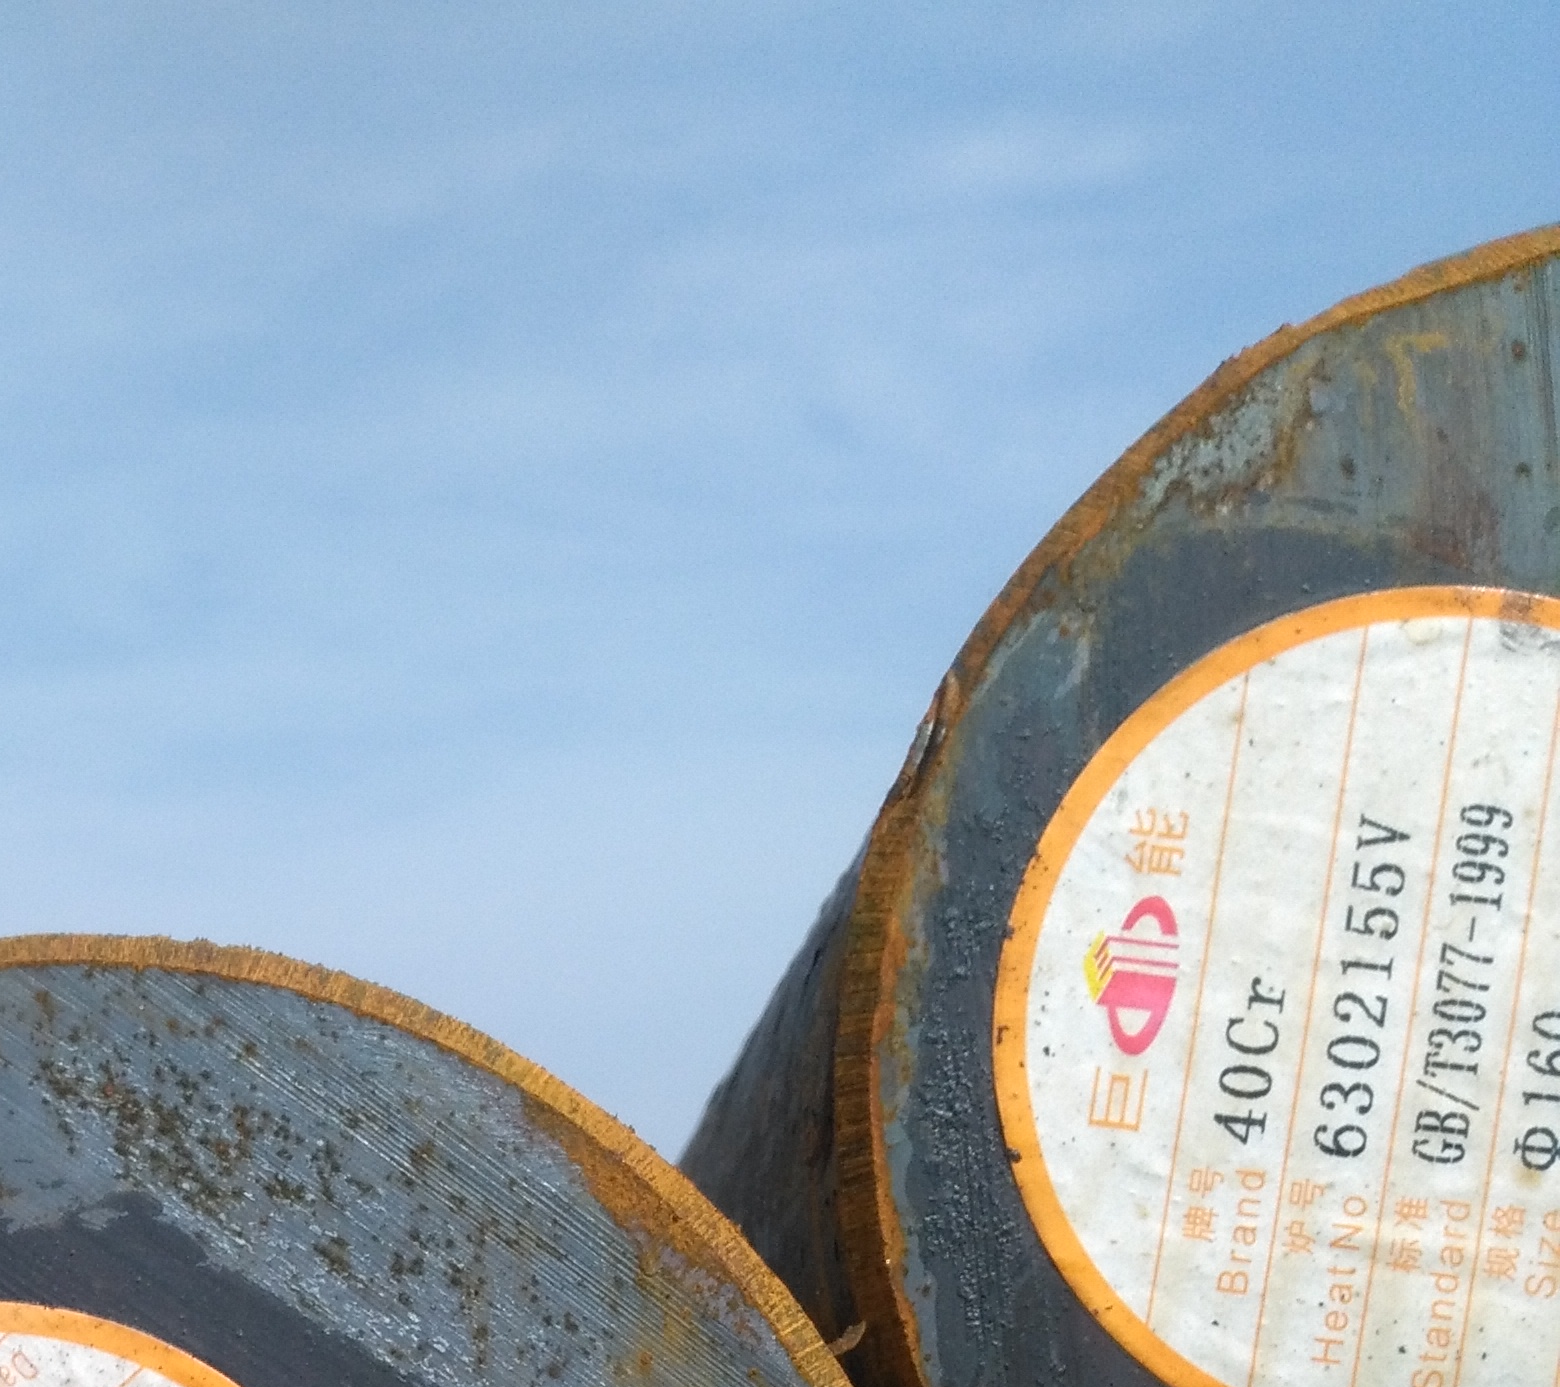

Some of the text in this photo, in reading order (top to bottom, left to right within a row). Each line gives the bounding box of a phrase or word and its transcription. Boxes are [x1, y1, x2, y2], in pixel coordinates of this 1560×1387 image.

[1313, 813, 1412, 1158] 6302155V
[1411, 804, 1513, 1164] GB/T3077-1999
[1214, 976, 1285, 1145] 40Cr
[1183, 1166, 1224, 1241] 牌号
[1216, 1168, 1266, 1296] Brand
[1282, 1178, 1327, 1254] 炉号
[1387, 1196, 1429, 1273] 标准
[1484, 1204, 1527, 1282] 规格
[1311, 1195, 1368, 1364] Heat No
